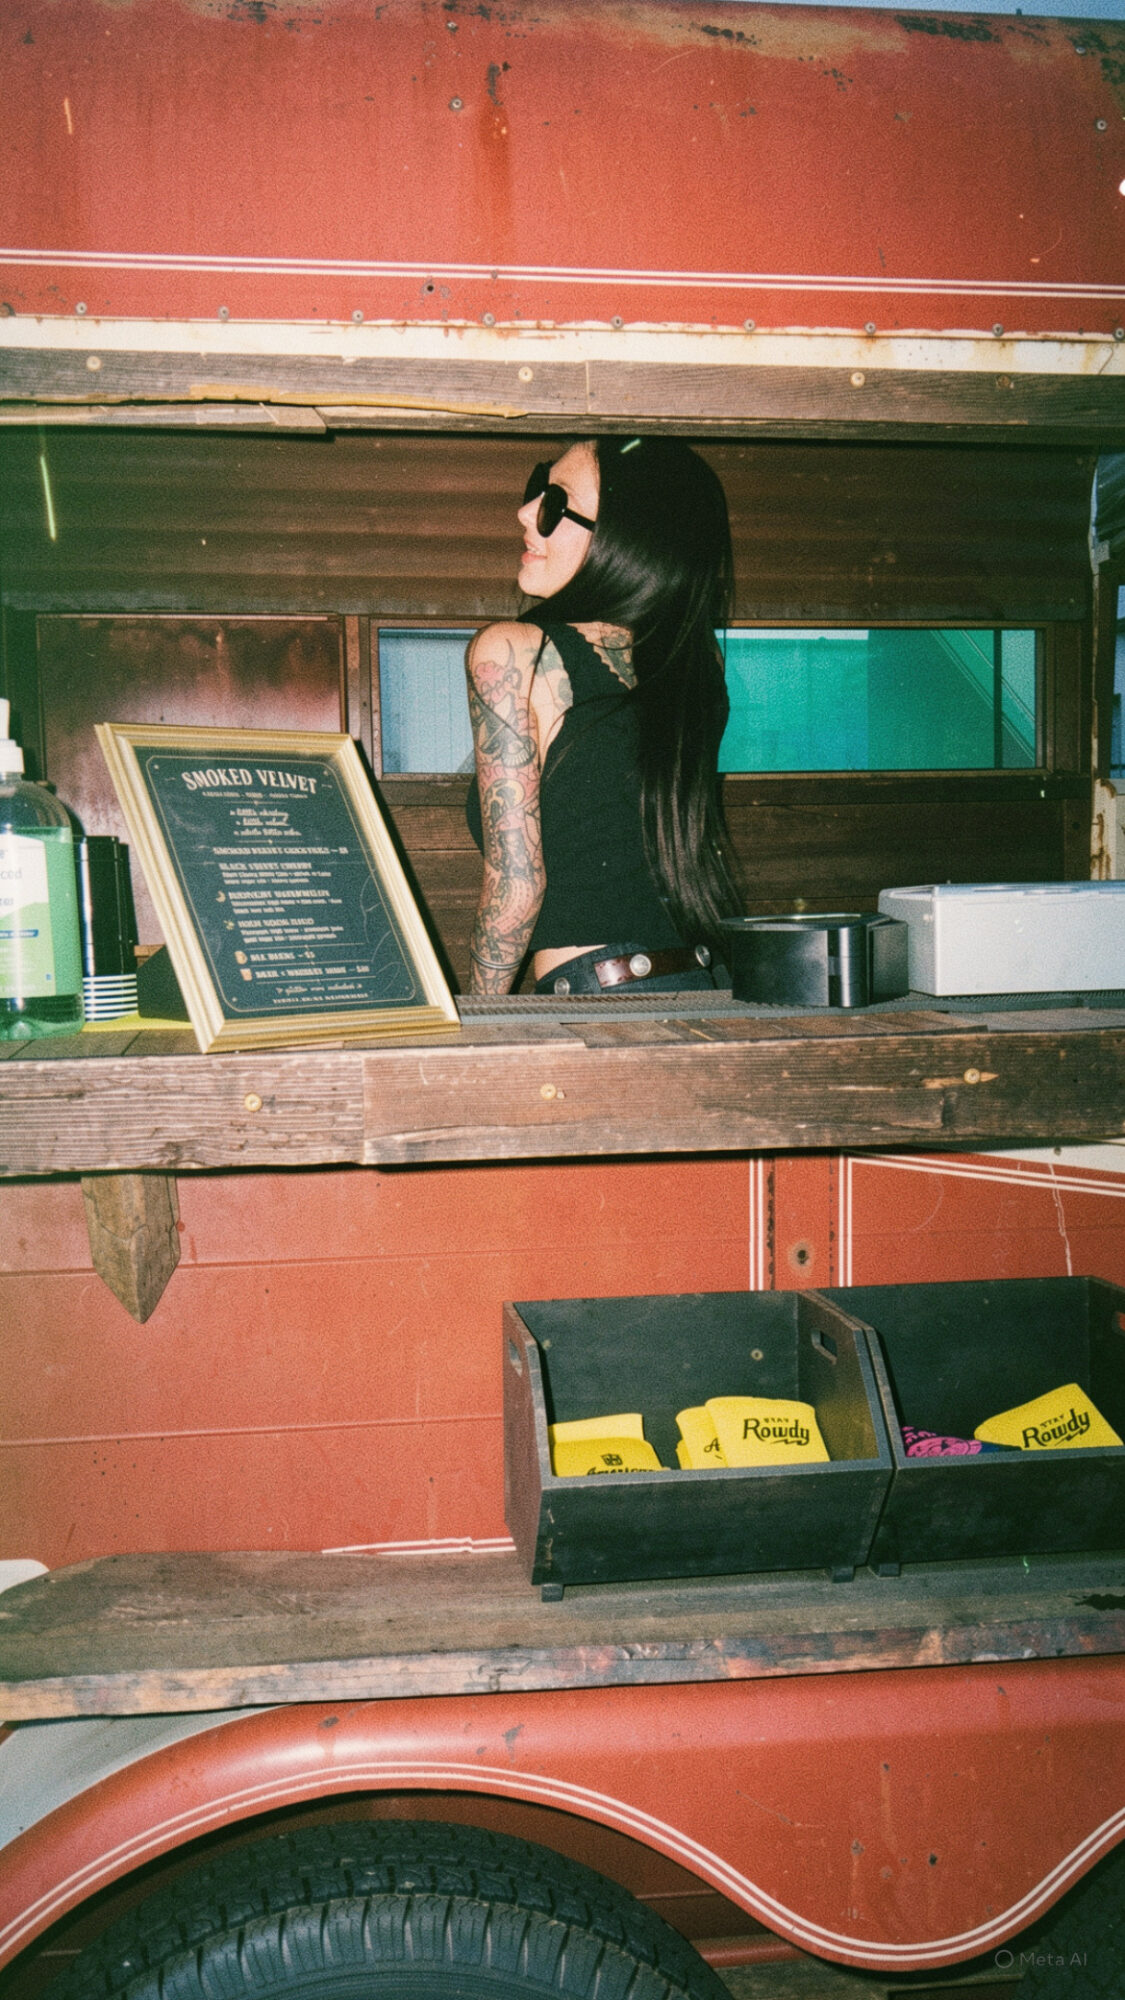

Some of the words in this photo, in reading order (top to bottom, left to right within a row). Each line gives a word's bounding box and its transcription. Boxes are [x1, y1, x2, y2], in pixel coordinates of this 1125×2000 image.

[181, 768, 253, 791] SMOKED
[255, 769, 317, 794] VELVET
[743, 1417, 810, 1446] Rowdy
[1022, 1408, 1091, 1449] Rowdy
